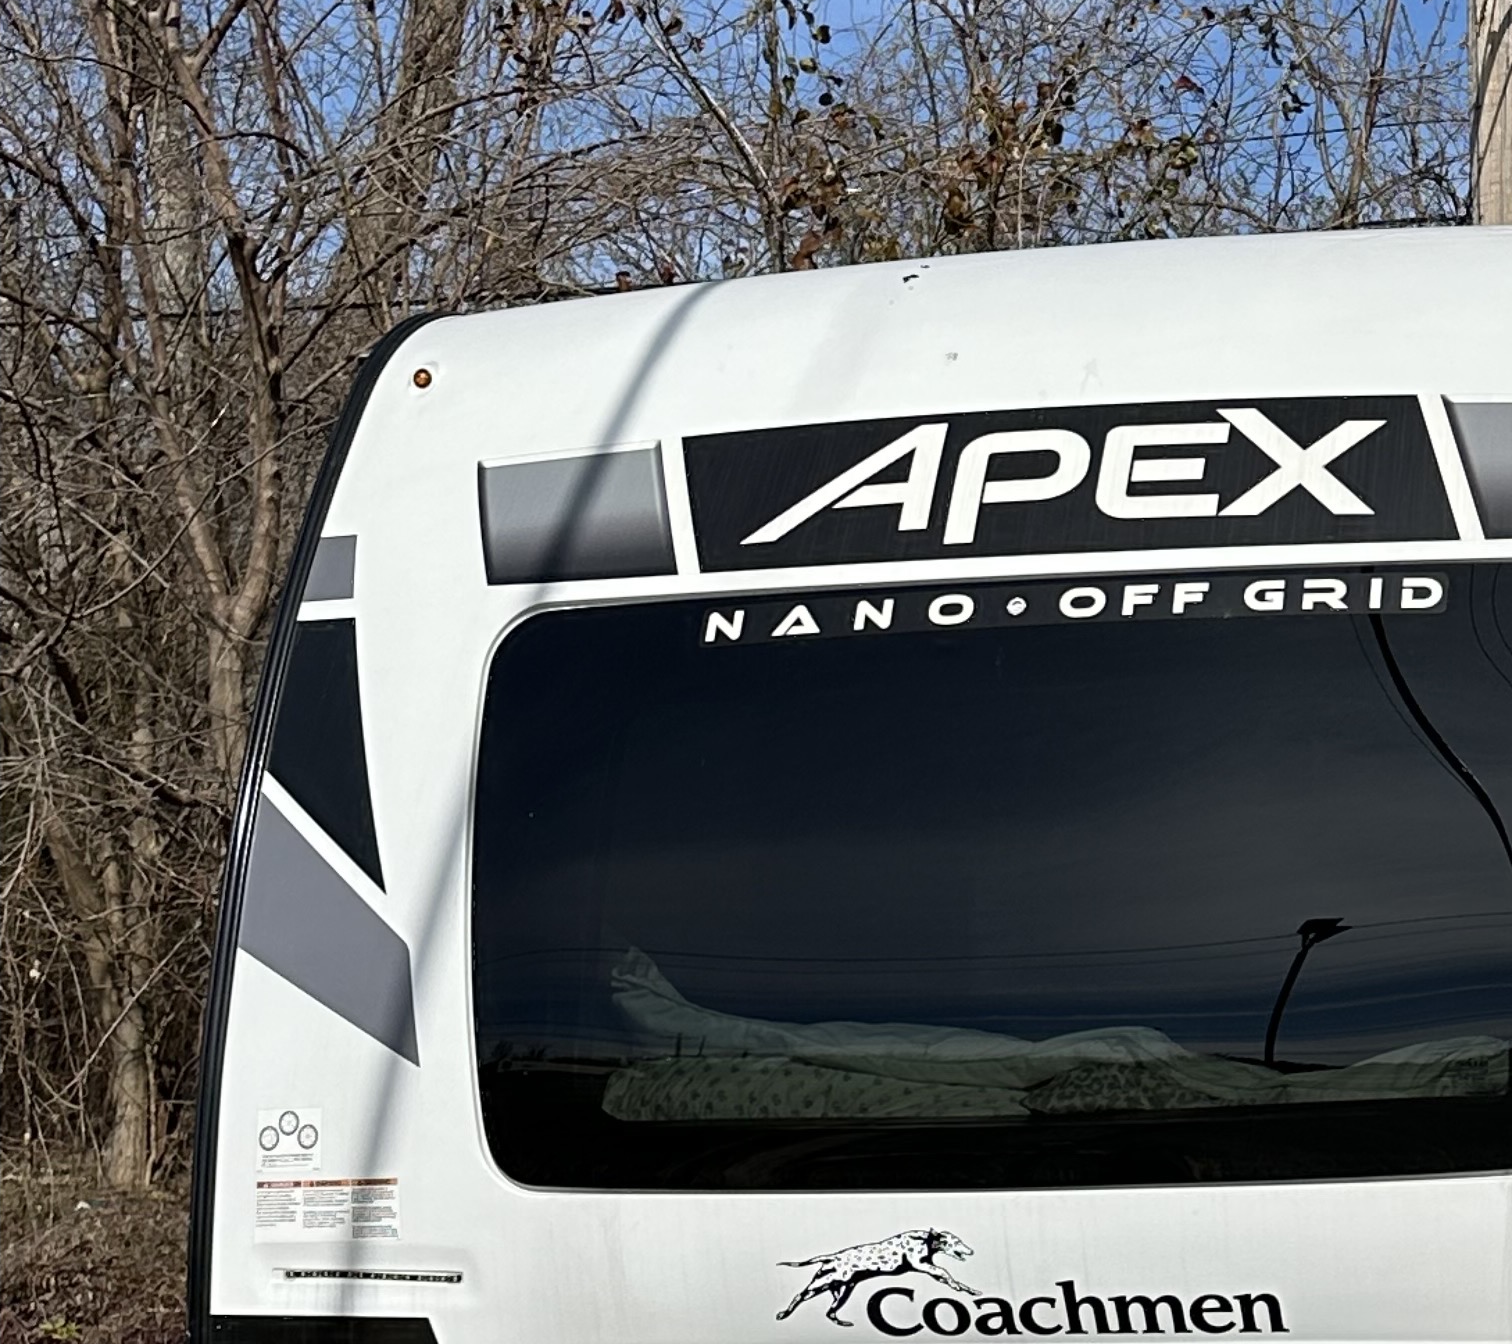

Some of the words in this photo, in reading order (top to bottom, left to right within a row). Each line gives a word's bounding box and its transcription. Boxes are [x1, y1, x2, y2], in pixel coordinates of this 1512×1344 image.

[740, 408, 1388, 545] APEX
[704, 594, 975, 644] NANO
[1059, 582, 1211, 618] OFF
[1243, 577, 1445, 611] GRID
[867, 1280, 1290, 1337] Coachmen
